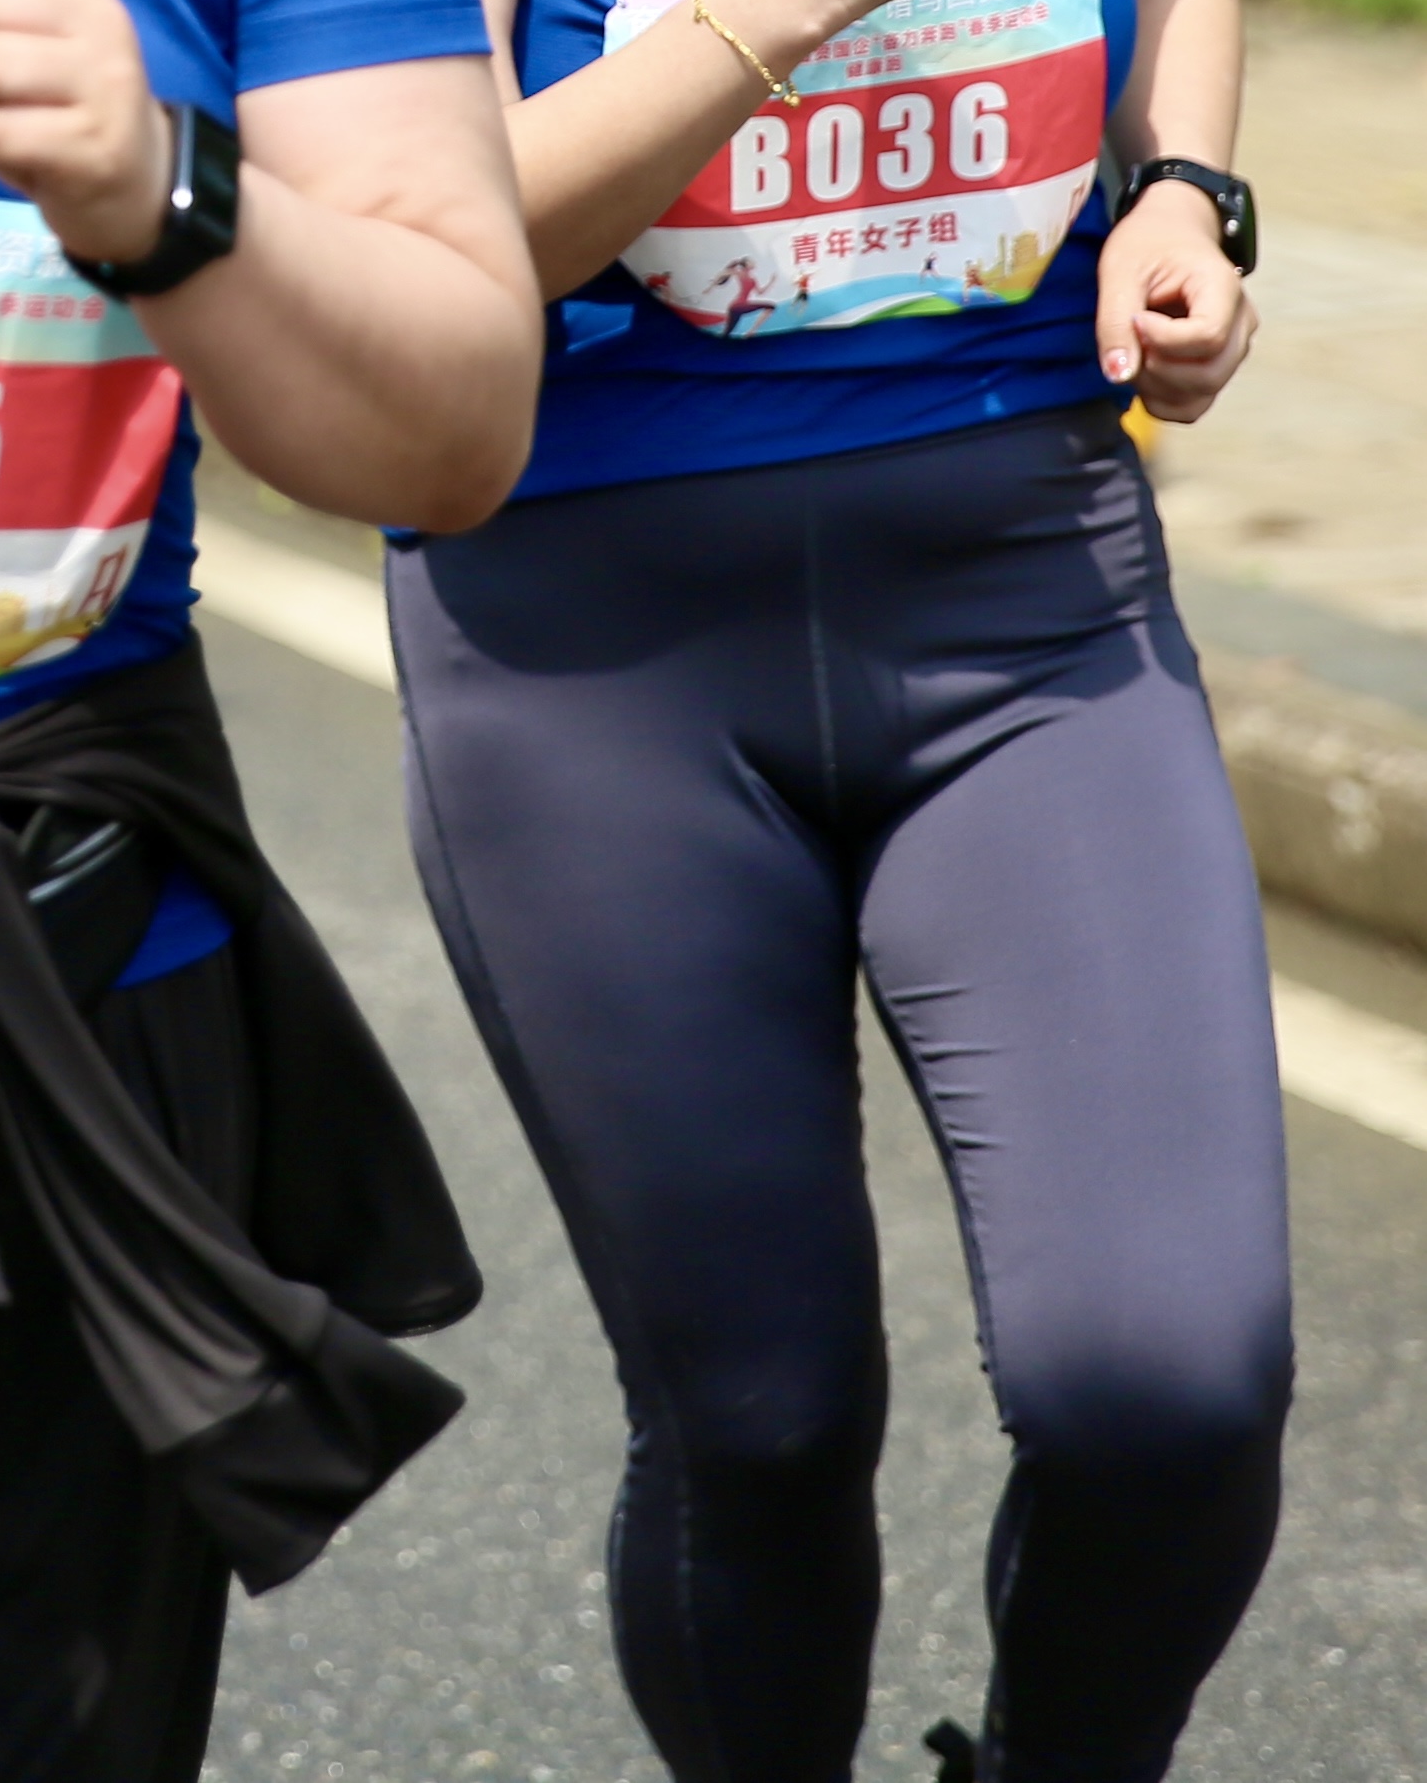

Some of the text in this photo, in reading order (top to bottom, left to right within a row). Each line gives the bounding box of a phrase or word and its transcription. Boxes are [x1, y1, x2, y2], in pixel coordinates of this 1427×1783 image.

[730, 82, 1009, 215] B036
[791, 212, 959, 266] 青年女子组
